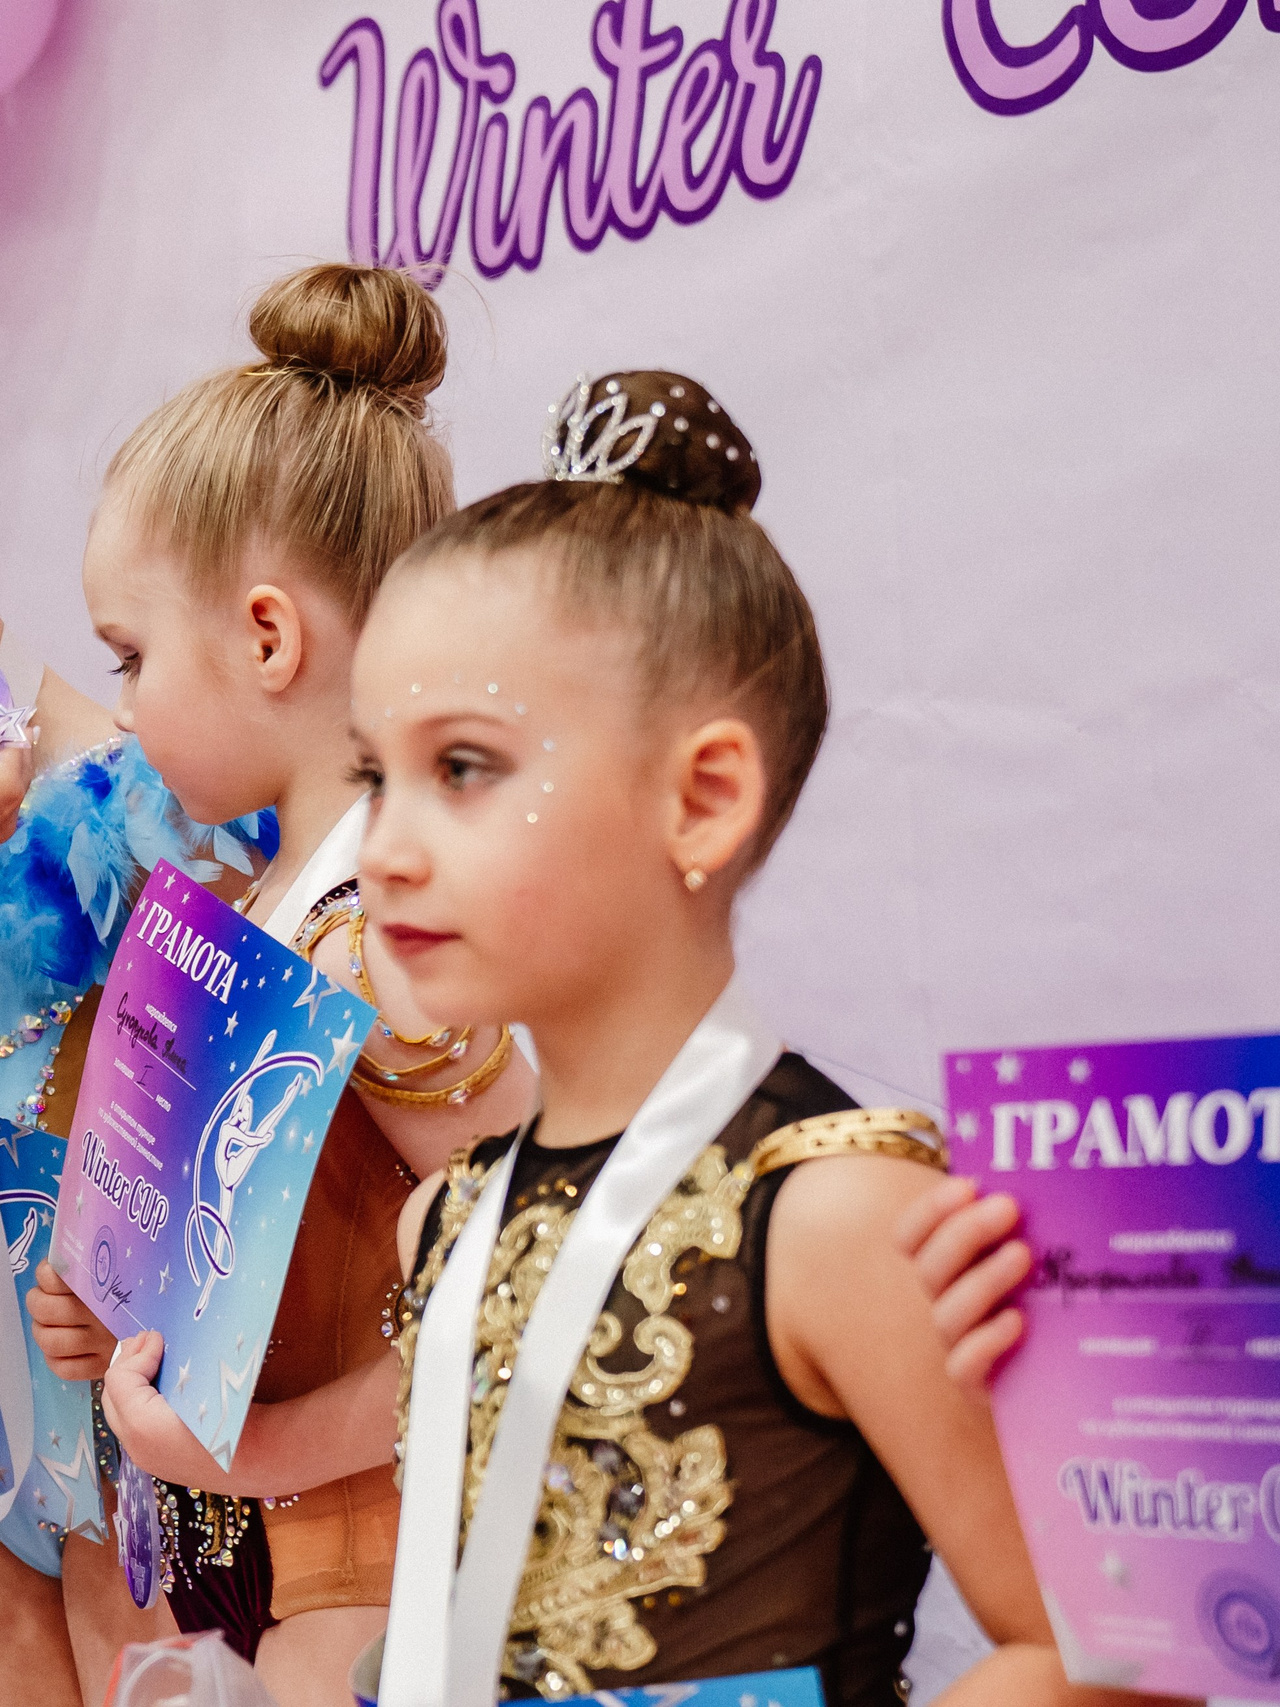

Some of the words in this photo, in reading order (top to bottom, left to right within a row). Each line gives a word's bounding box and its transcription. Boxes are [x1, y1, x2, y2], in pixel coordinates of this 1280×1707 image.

[319, 0, 822, 290] Winter
[136, 901, 239, 1005] ГРАМОТА
[82, 1129, 130, 1209] Winter
[127, 1175, 170, 1241] CUP
[1058, 1457, 1260, 1543] Winter
